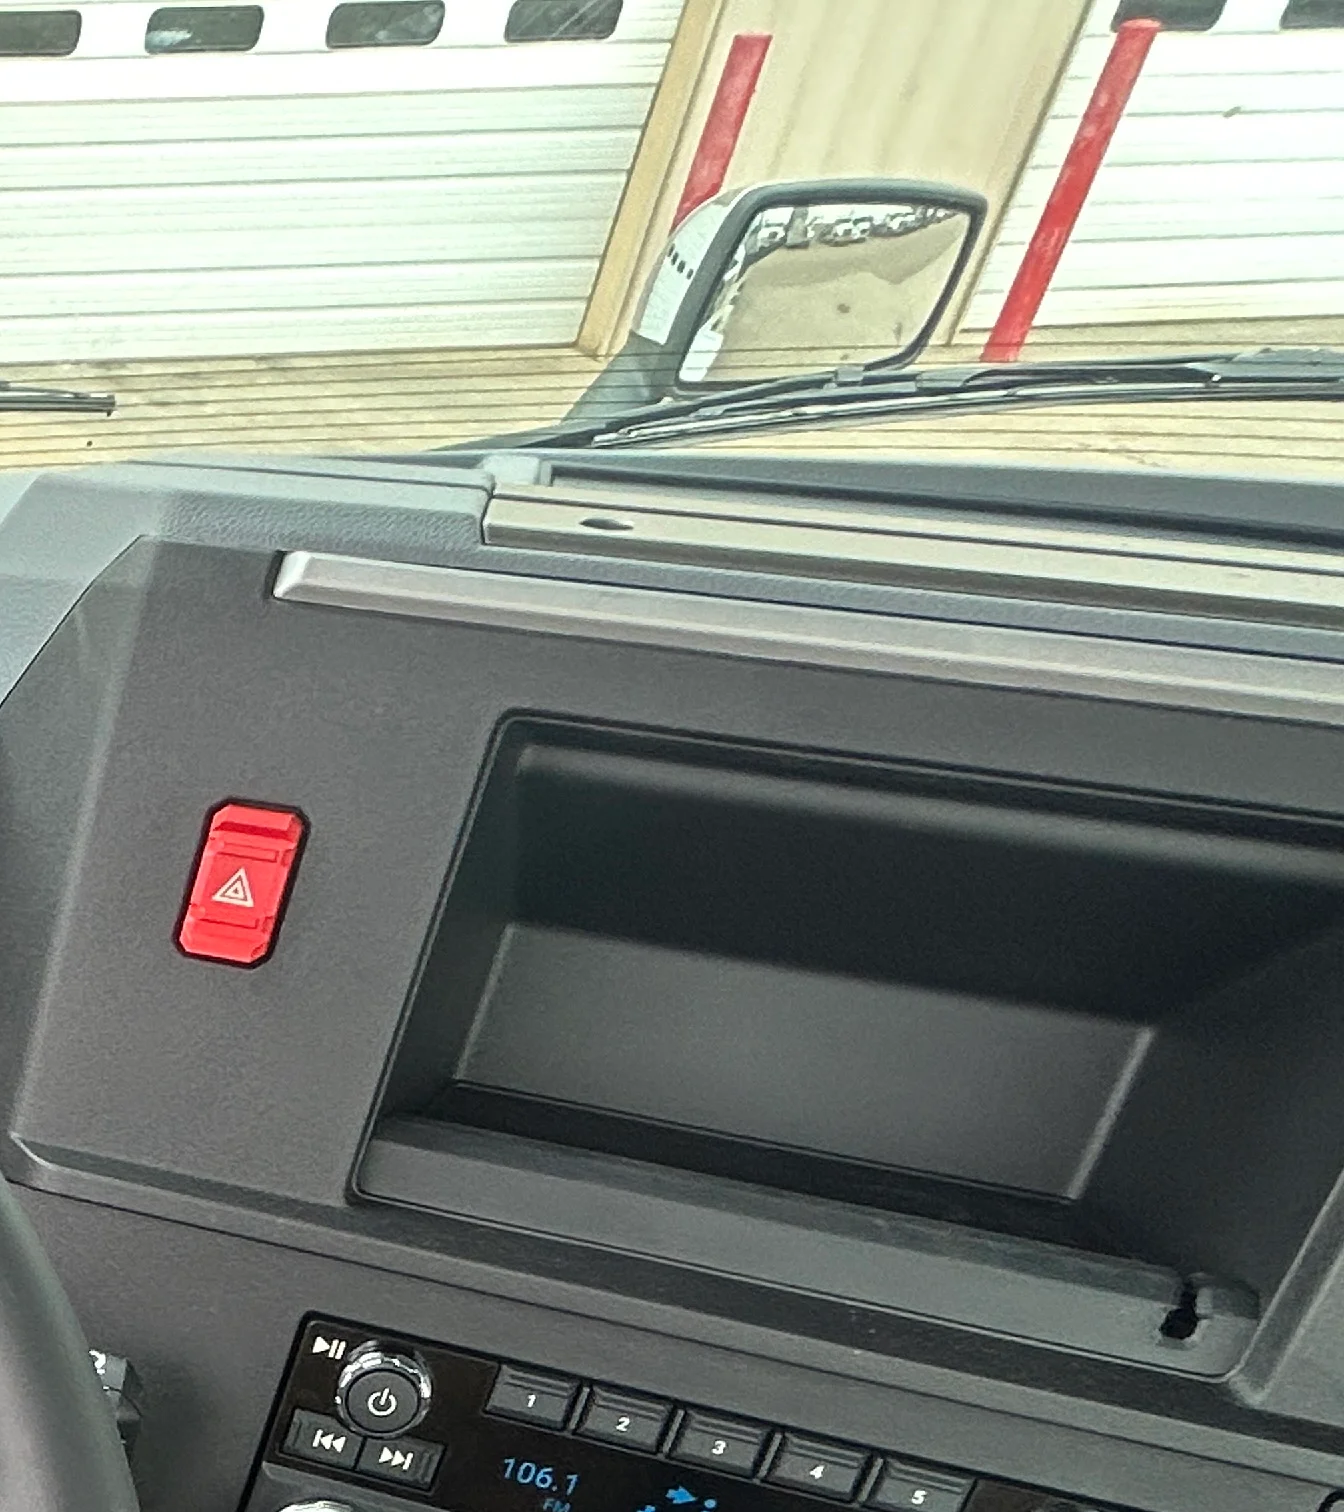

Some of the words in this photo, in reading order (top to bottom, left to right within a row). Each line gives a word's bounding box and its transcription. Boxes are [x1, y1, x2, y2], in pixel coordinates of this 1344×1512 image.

[527, 1394, 537, 1408] 1
[615, 1416, 630, 1432] 2
[711, 1439, 727, 1455] 3
[503, 1458, 579, 1496] 106.1
[809, 1464, 826, 1480] 4
[911, 1489, 928, 1505] 5
